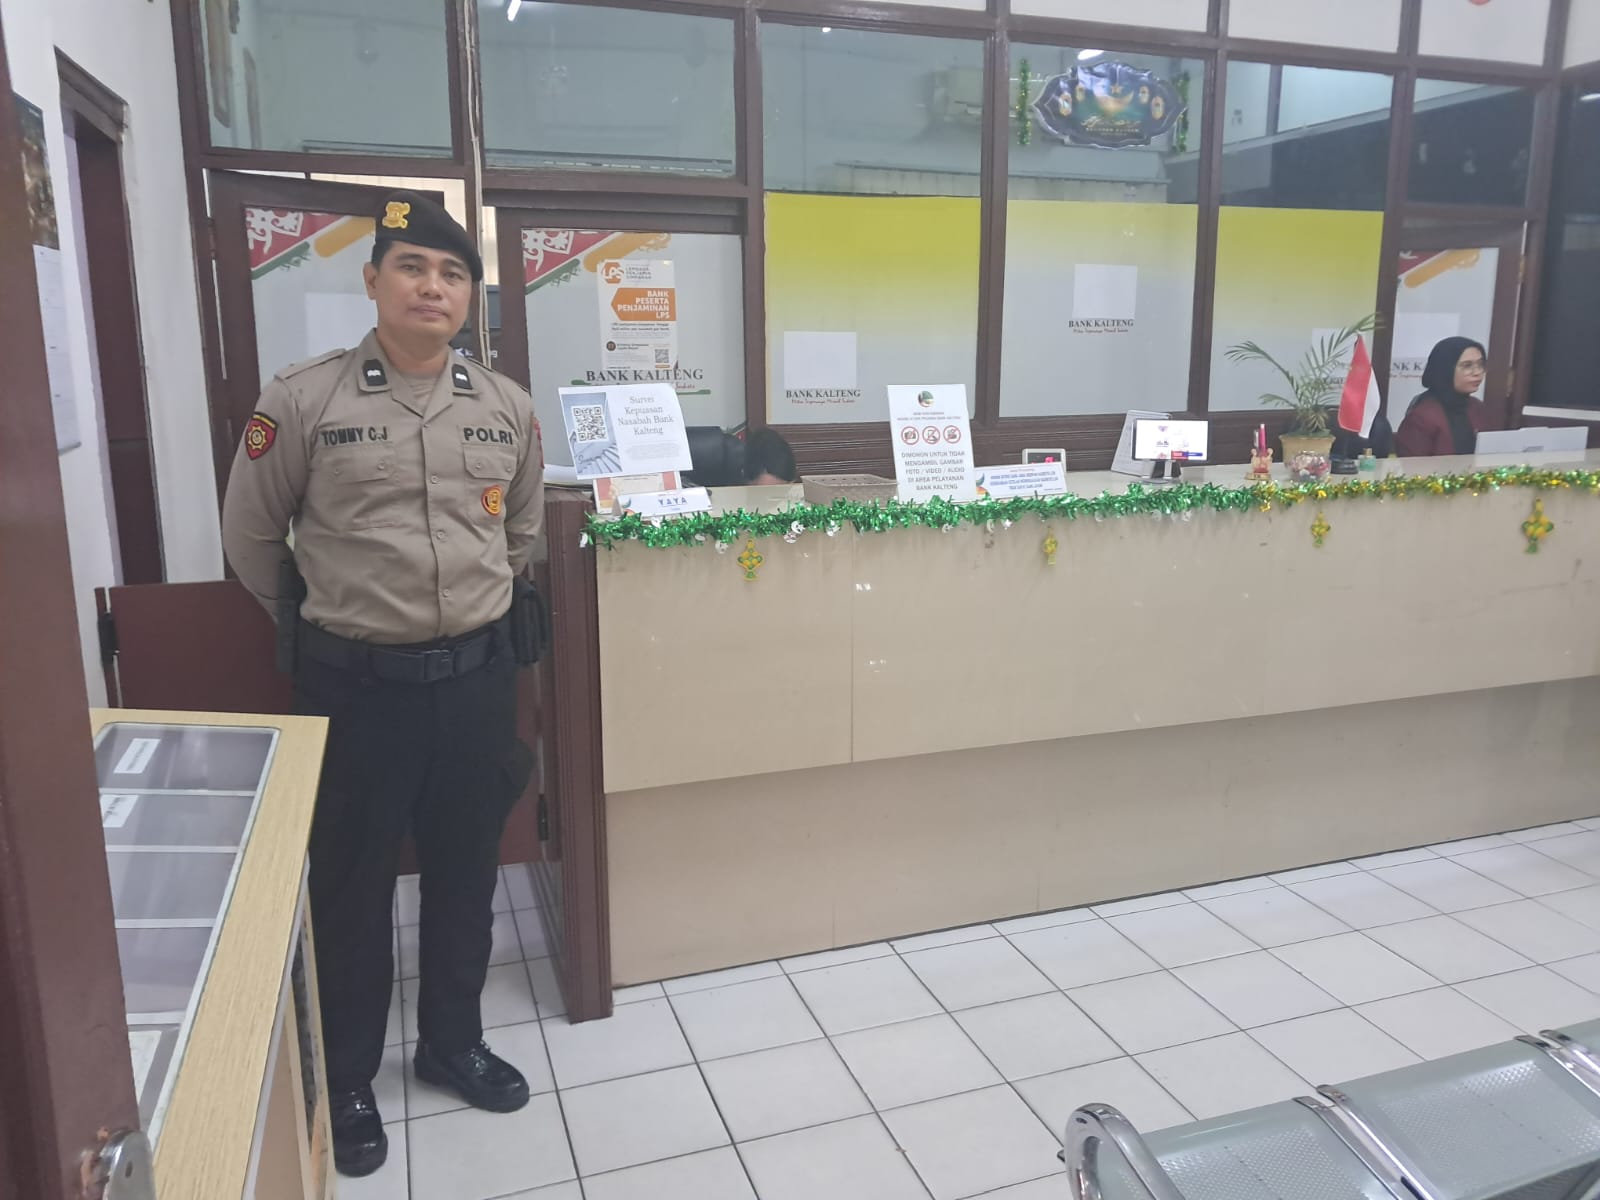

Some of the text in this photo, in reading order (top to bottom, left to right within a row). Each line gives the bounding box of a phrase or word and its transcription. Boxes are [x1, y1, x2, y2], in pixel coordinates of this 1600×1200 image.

[602, 266, 624, 280] LPS
[617, 304, 669, 312] PENJAMINAN
[655, 311, 670, 319] LPS
[1068, 319, 1134, 328] BANK KALTENG
[586, 368, 704, 381] BANK KALTENG
[786, 389, 861, 398] BANK KALTENG
[629, 396, 655, 404] Survei
[624, 406, 663, 416] Kepuasan
[618, 415, 674, 426] Nasabah Bank
[463, 427, 514, 445] POLRI
[634, 427, 664, 436] Kalteng
[321, 427, 363, 446] TOMMY
